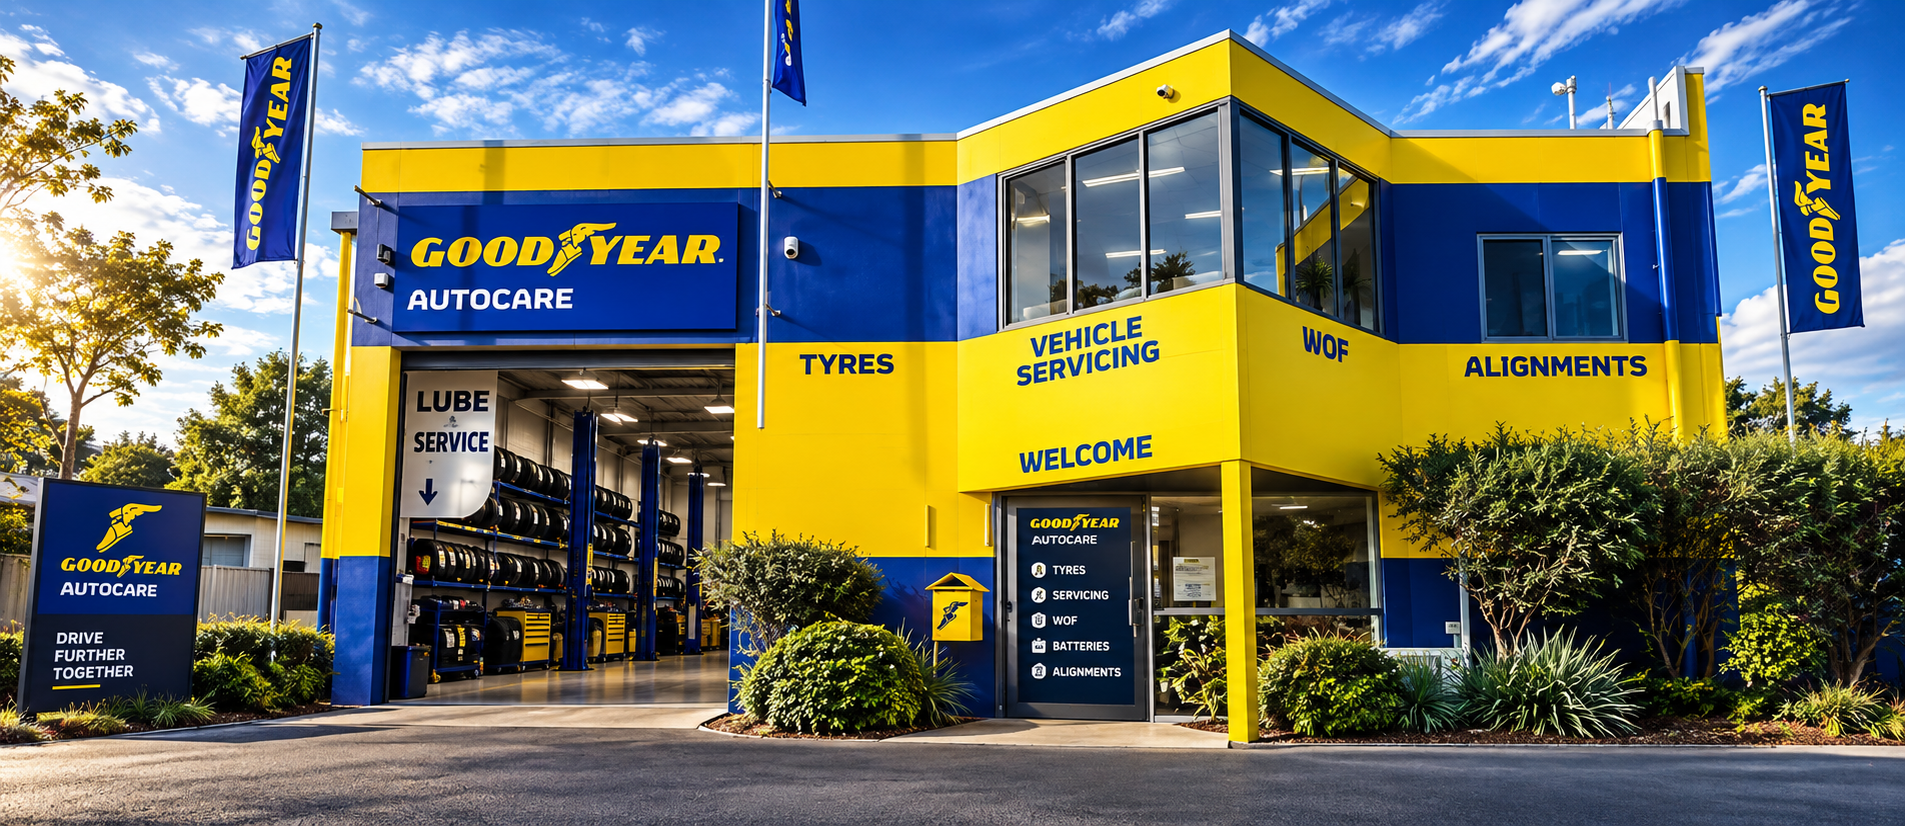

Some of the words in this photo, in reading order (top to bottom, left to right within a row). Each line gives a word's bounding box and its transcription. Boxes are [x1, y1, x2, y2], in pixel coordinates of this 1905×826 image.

[247, 56, 292, 250] GOODYEAR
[1802, 103, 1840, 314] GOODYEAR
[410, 232, 718, 268] GOODYEAR
[407, 288, 574, 311] AUTOCARE
[1030, 316, 1143, 358] VEHICLE
[1302, 325, 1349, 363] WOF
[799, 353, 895, 375] TYRES
[1016, 340, 1160, 387] SERVICING
[1464, 355, 1648, 378] ALIGNMENTS
[416, 390, 490, 412] LUBE
[413, 431, 489, 453] SERVICE
[1019, 434, 1153, 474] WELCOME
[1029, 517, 1120, 529] GOODYEAR
[1031, 534, 1098, 545] AUTOCARE
[60, 556, 183, 576] GOODYEAR
[1052, 565, 1086, 575] TYRES
[60, 581, 158, 598] AUTOCARE
[1052, 590, 1109, 600] SERVICING
[1052, 615, 1078, 625] WOF
[56, 631, 104, 645] DRIVE
[1052, 641, 1110, 652] BATTERIES
[54, 648, 126, 663] FURTHER
[53, 665, 134, 680] TOGETHER
[1052, 666, 1122, 677] ALIGNMENTS
